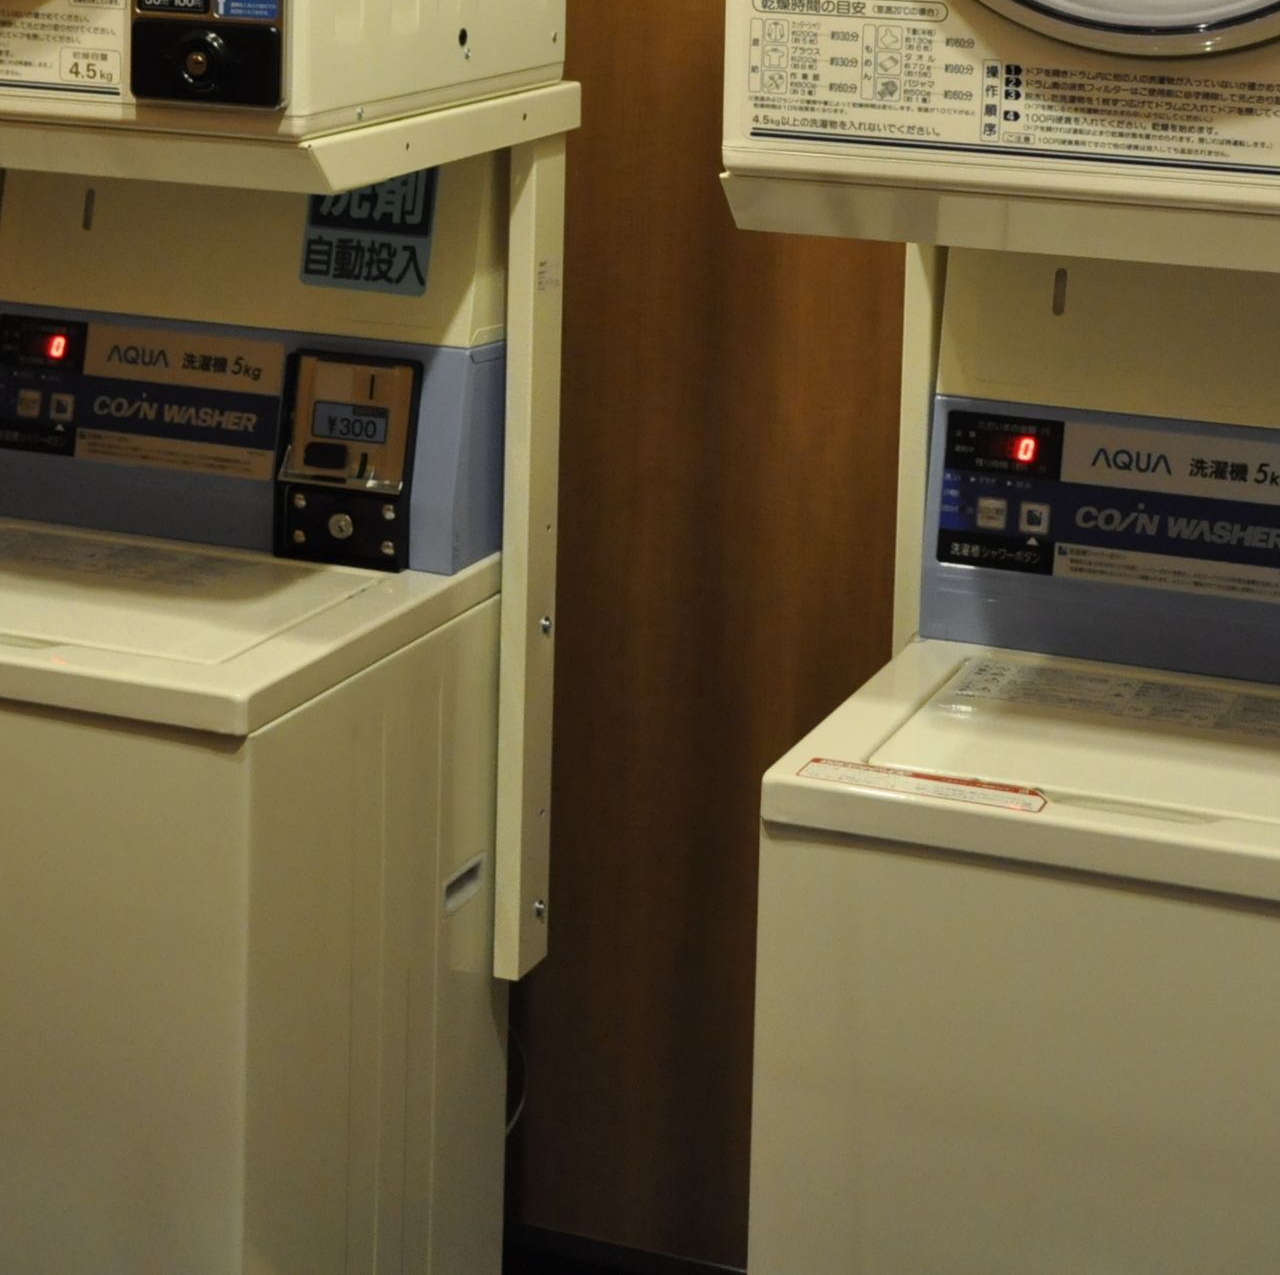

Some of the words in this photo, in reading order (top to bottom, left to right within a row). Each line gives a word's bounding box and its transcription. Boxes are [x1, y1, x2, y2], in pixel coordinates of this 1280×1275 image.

[69, 61, 97, 80] 4.5
[99, 69, 114, 83] kg
[304, 235, 426, 287] 自動投入
[50, 335, 66, 358] 0
[106, 344, 169, 368] AQUA
[181, 352, 228, 374] 洗濯機
[163, 403, 258, 433] WASHER
[327, 415, 377, 439] ¥300
[1017, 437, 1036, 461] 0
[1091, 447, 1172, 475] AQUA
[1188, 457, 1248, 483] 洗濯機
